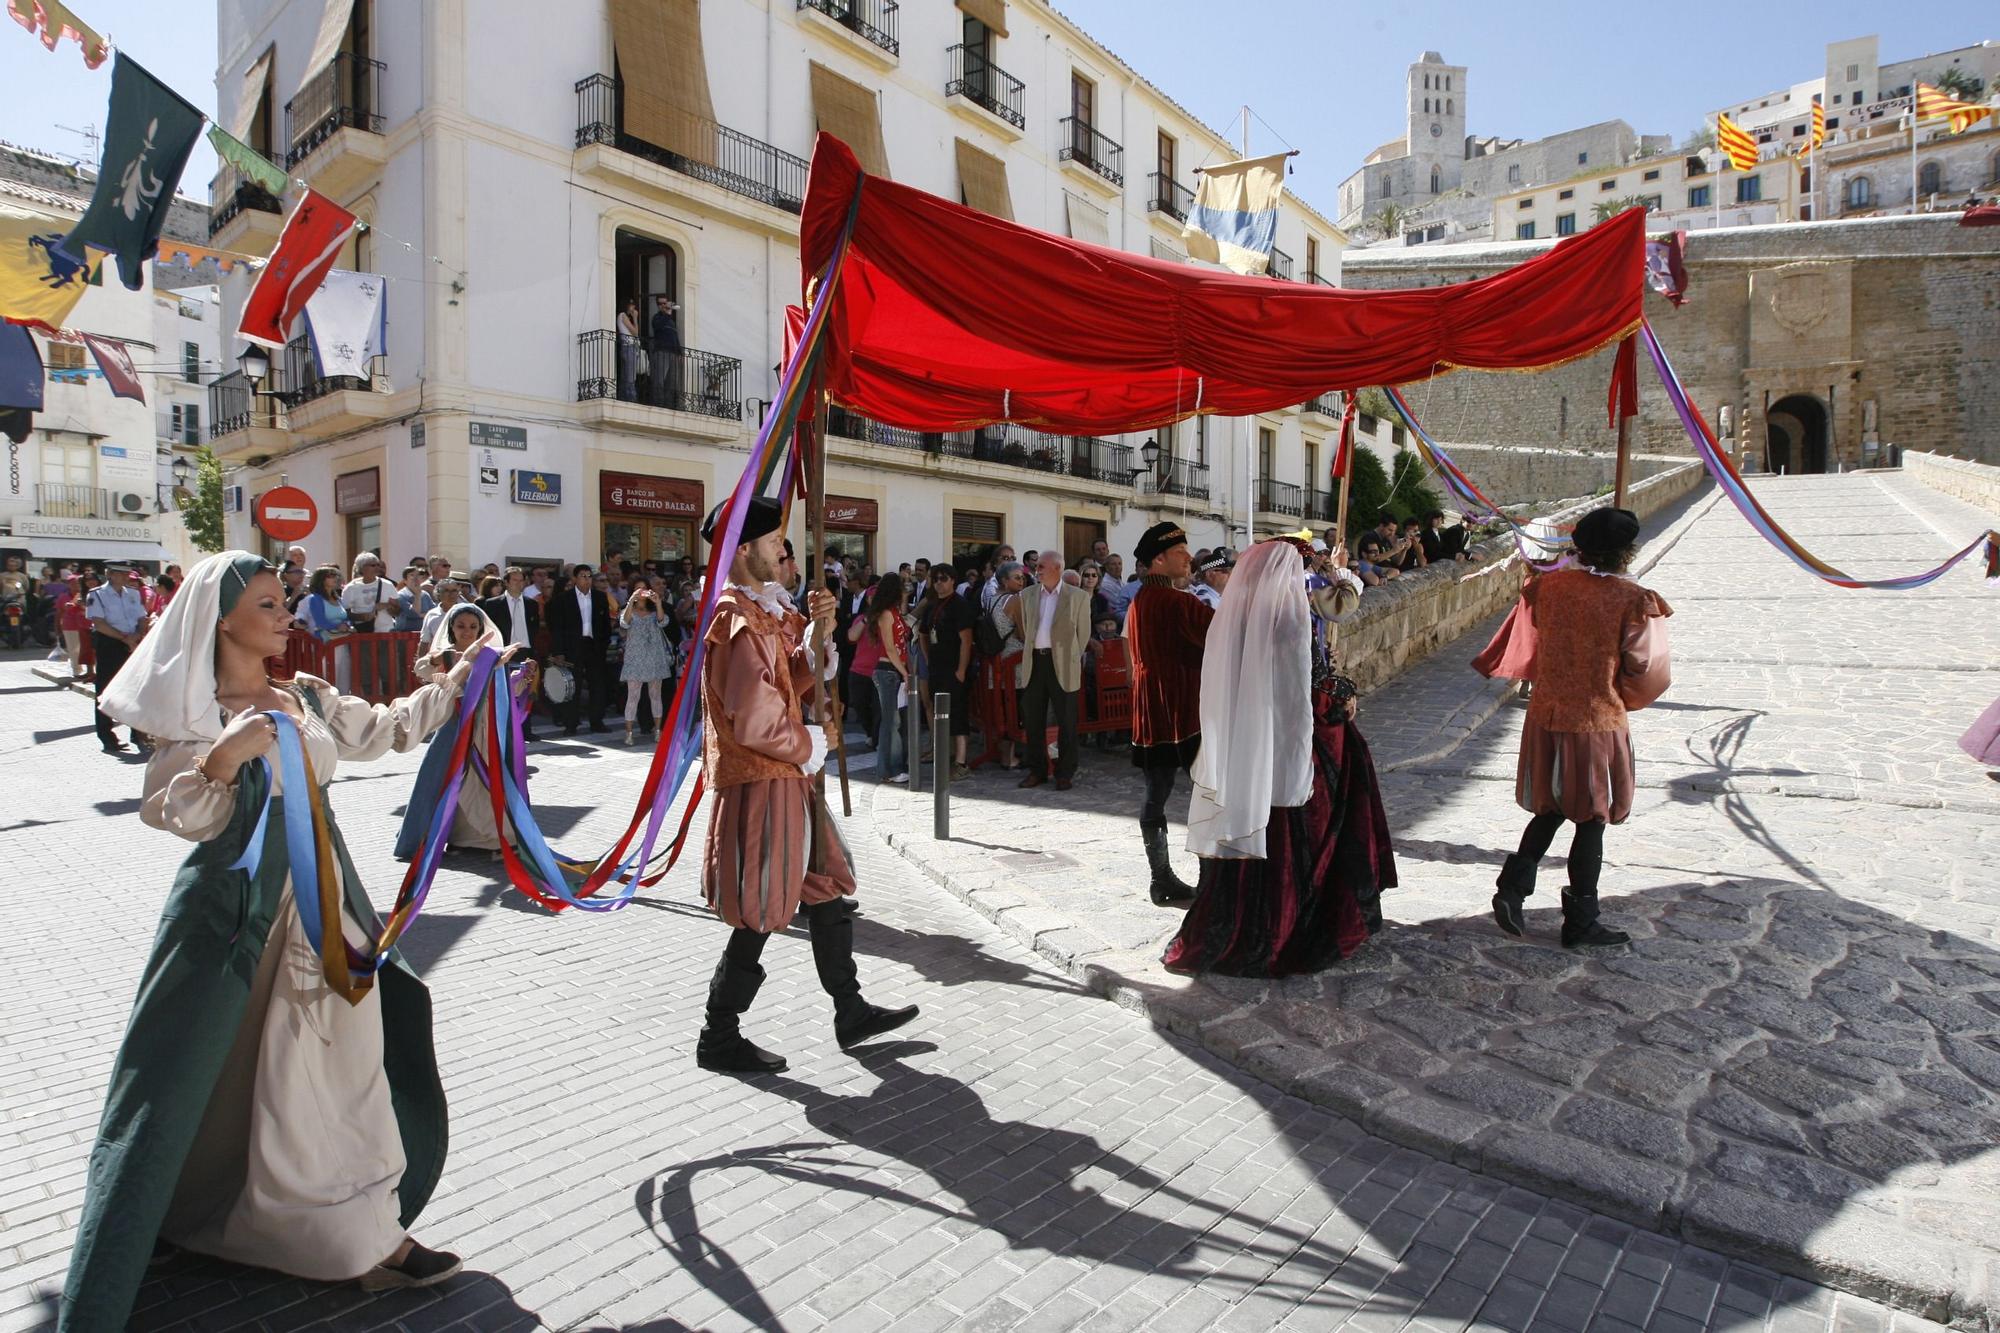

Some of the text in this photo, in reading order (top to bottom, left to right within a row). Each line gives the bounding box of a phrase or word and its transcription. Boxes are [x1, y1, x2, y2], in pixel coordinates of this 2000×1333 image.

[520, 491, 558, 502] TELEBANCO
[626, 499, 696, 511] CREDITO BALEAR
[21, 522, 90, 536] PELUQUERIA
[96, 526, 142, 537] ANTONIO
